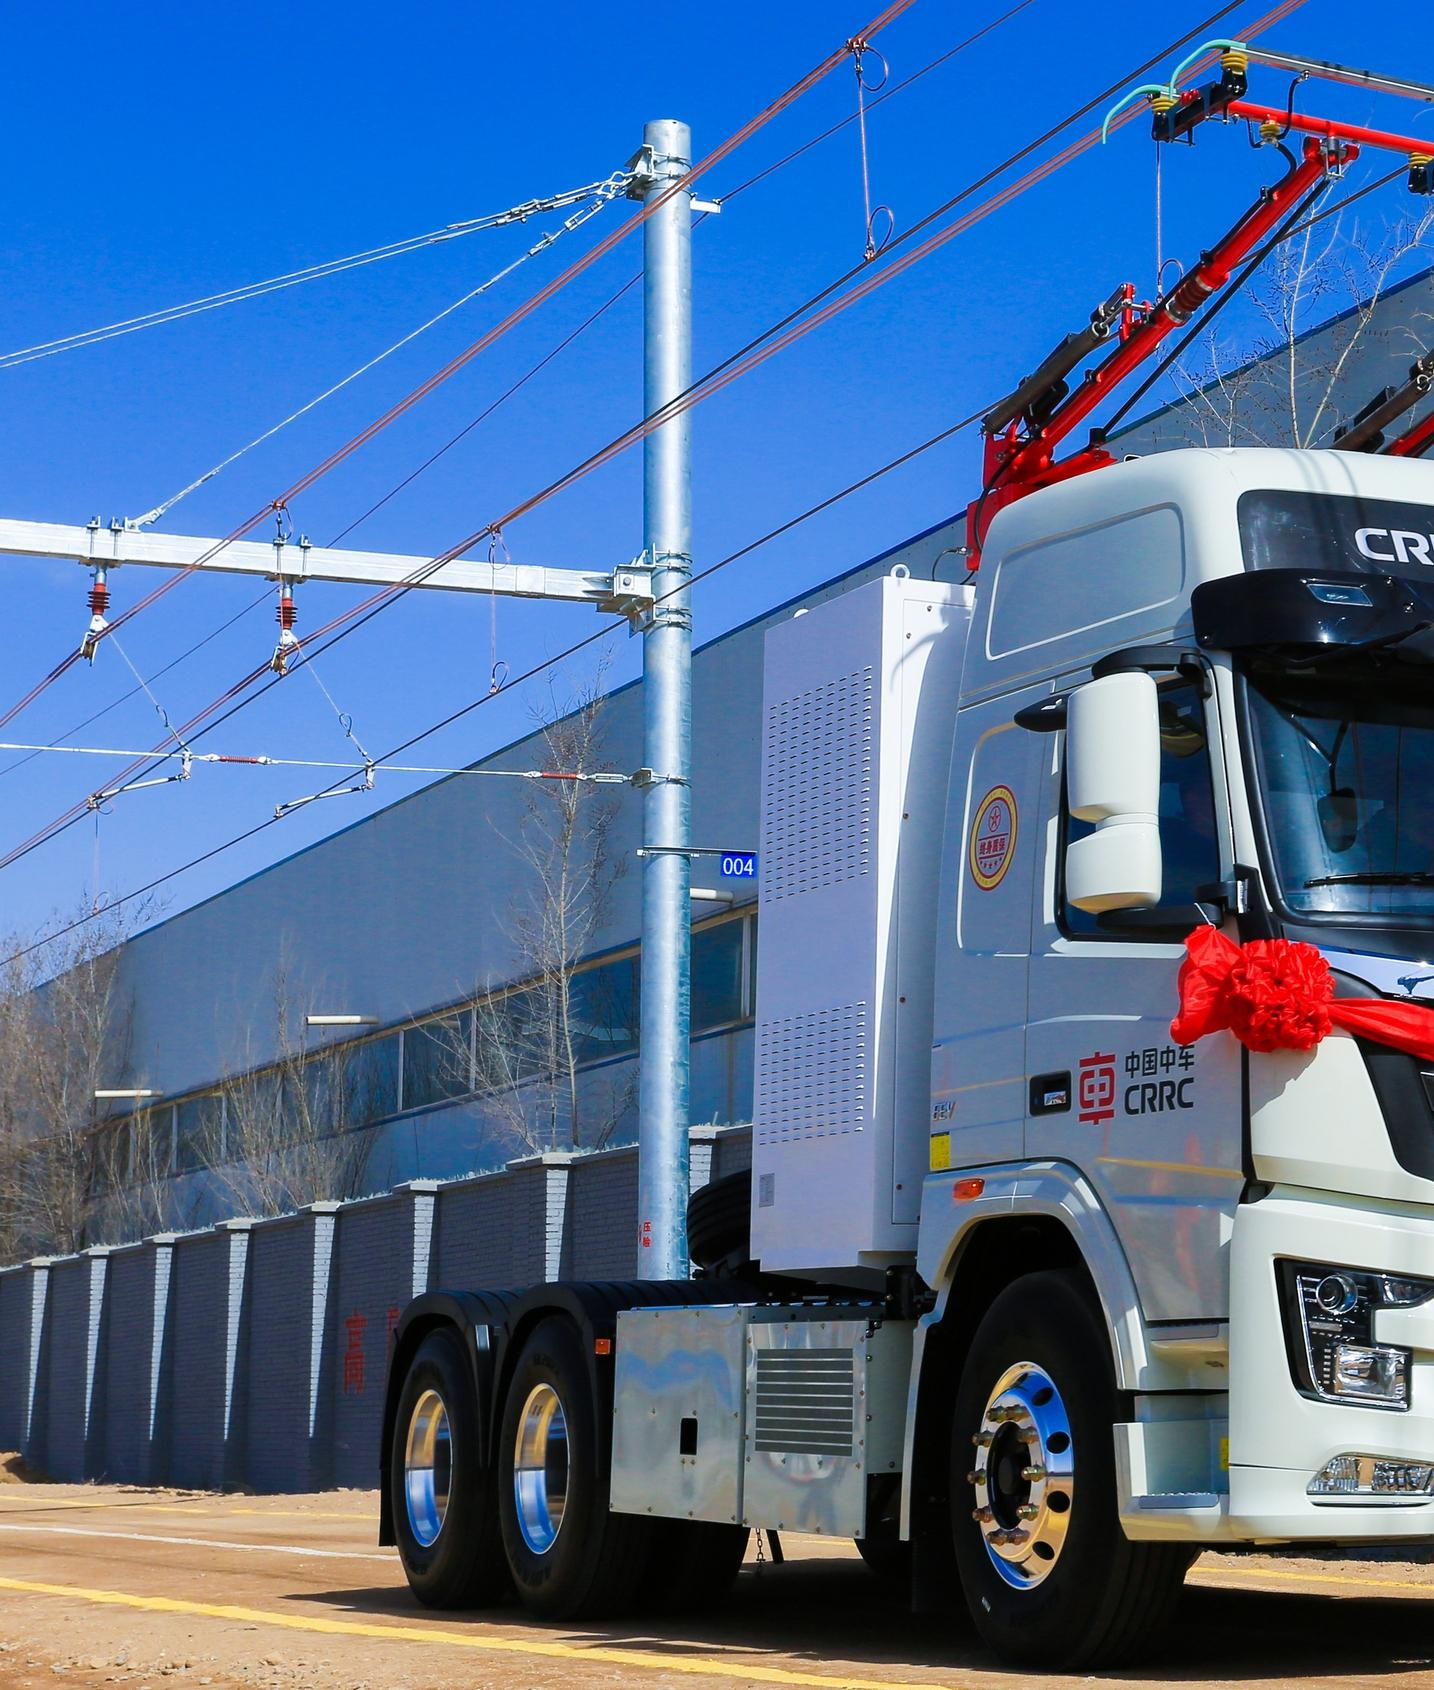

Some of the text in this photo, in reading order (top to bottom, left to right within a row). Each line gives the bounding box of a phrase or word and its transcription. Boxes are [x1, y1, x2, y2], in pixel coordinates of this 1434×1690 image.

[723, 857, 754, 876] 004
[1125, 1045, 1195, 1079] 中国中车
[1125, 1077, 1195, 1115] CRRC
